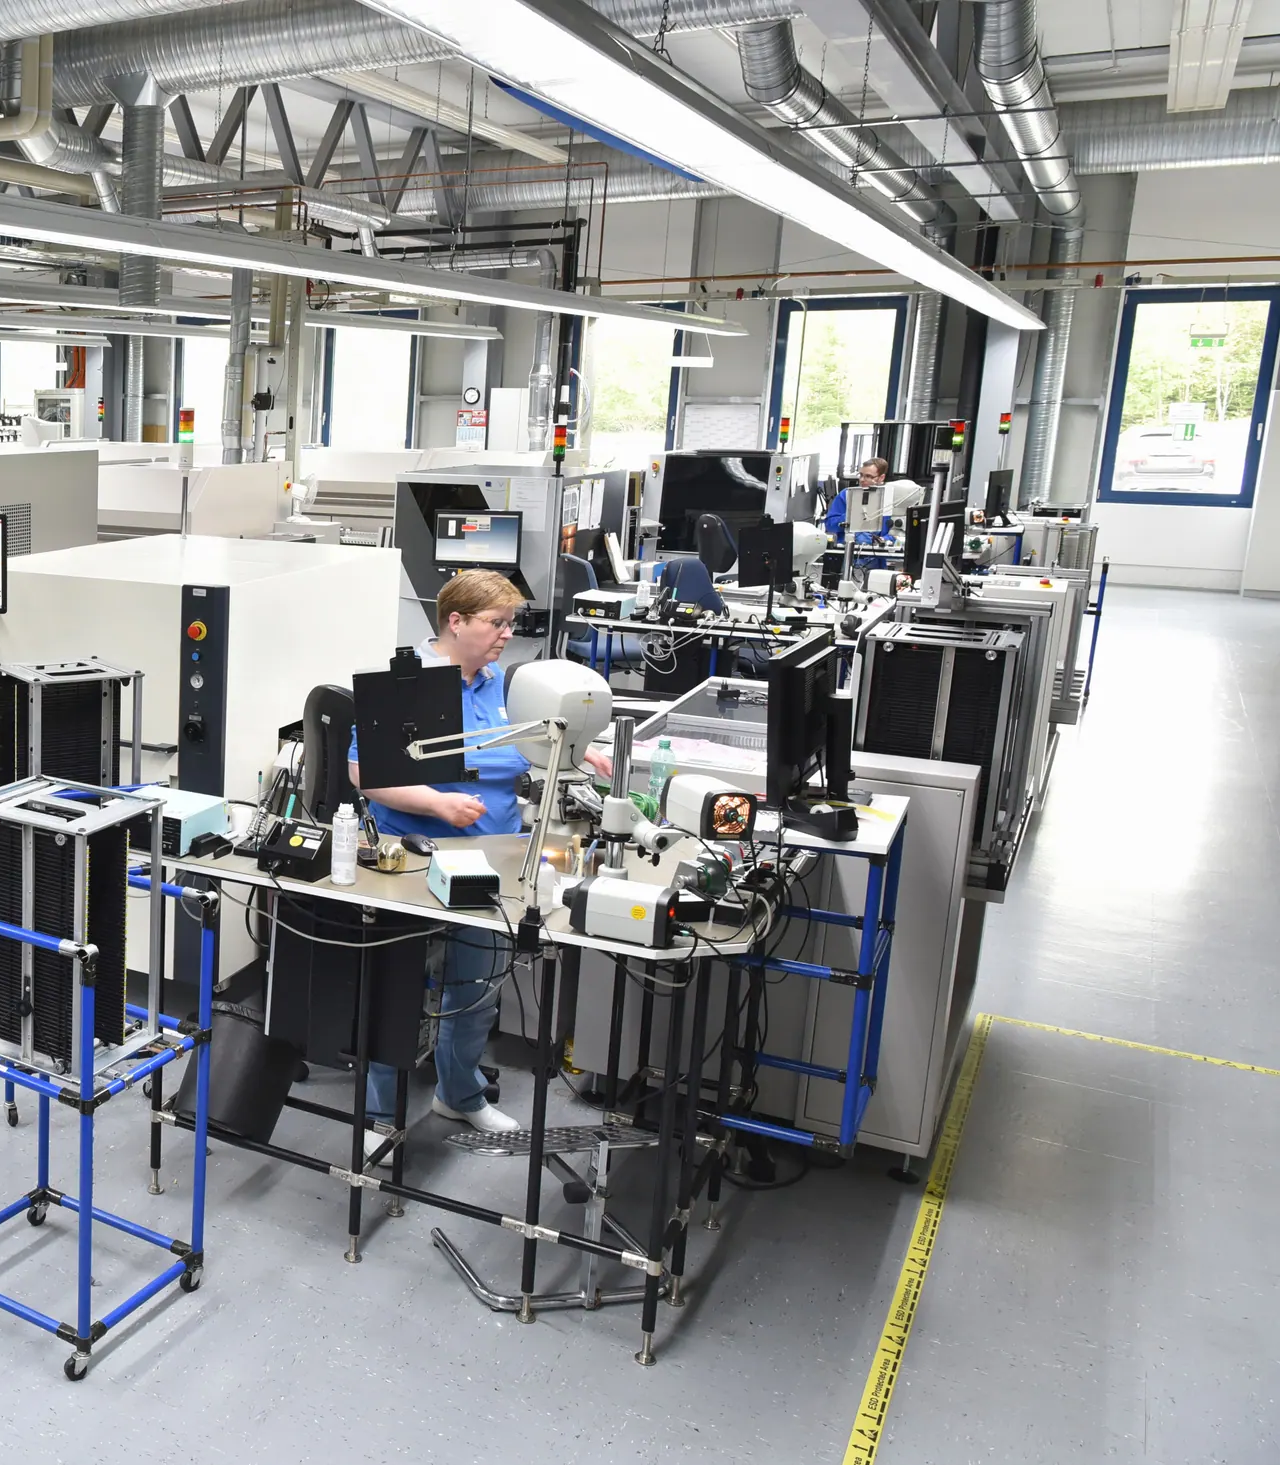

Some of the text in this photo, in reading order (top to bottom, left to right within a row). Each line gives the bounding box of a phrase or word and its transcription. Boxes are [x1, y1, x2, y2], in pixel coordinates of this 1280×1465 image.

[917, 1208, 934, 1246] ESD Protected Area
[895, 1278, 915, 1321] ESD Protected Area
[868, 1358, 891, 1411] ESD Protected Area
